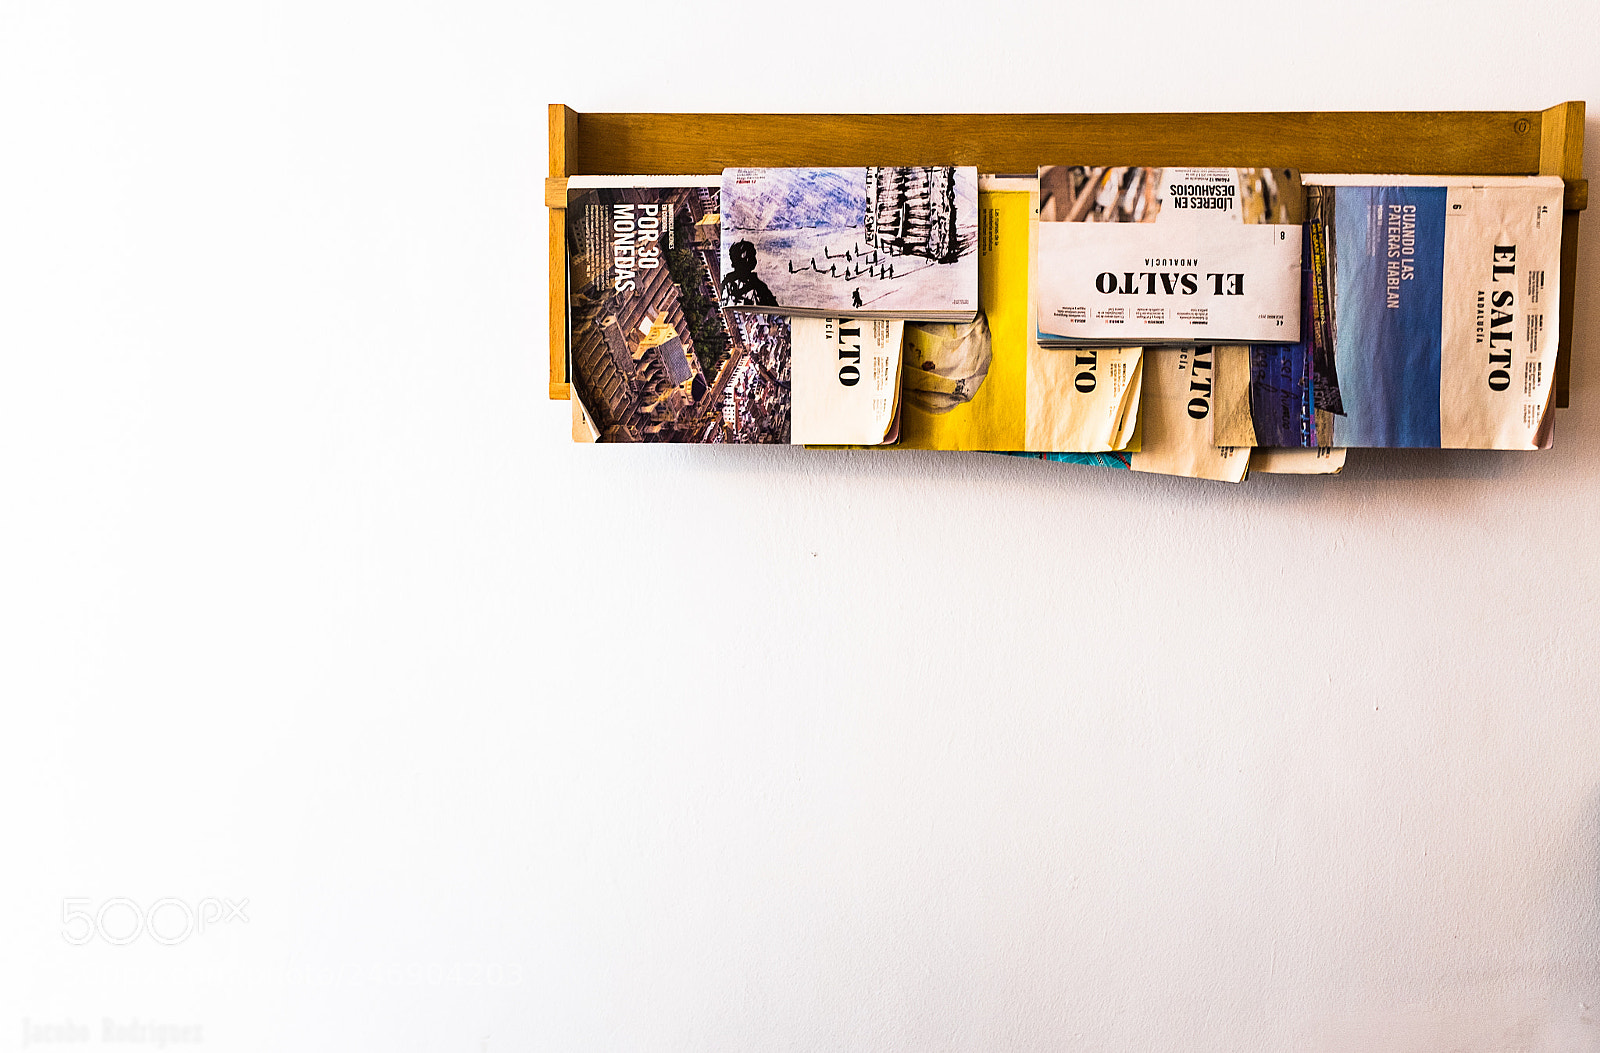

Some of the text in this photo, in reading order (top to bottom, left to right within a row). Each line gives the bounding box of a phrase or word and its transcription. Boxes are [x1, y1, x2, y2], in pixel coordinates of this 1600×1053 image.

[1170, 184, 1235, 196] DESAHUCIOS
[1174, 197, 1232, 212] LÍDERES EN
[613, 204, 635, 291] MONEDAS
[638, 204, 659, 268] POR 30
[1280, 231, 1285, 240] 8
[1387, 205, 1400, 308] PATERAS HABLAN
[1401, 205, 1416, 280] CUANDO LAS
[1095, 272, 1244, 296] EL SALTO
[1144, 258, 1198, 267] ANDALUCÍA
[1476, 291, 1485, 343] ANDALUCÍA
[1488, 244, 1516, 392] EL SALTO
